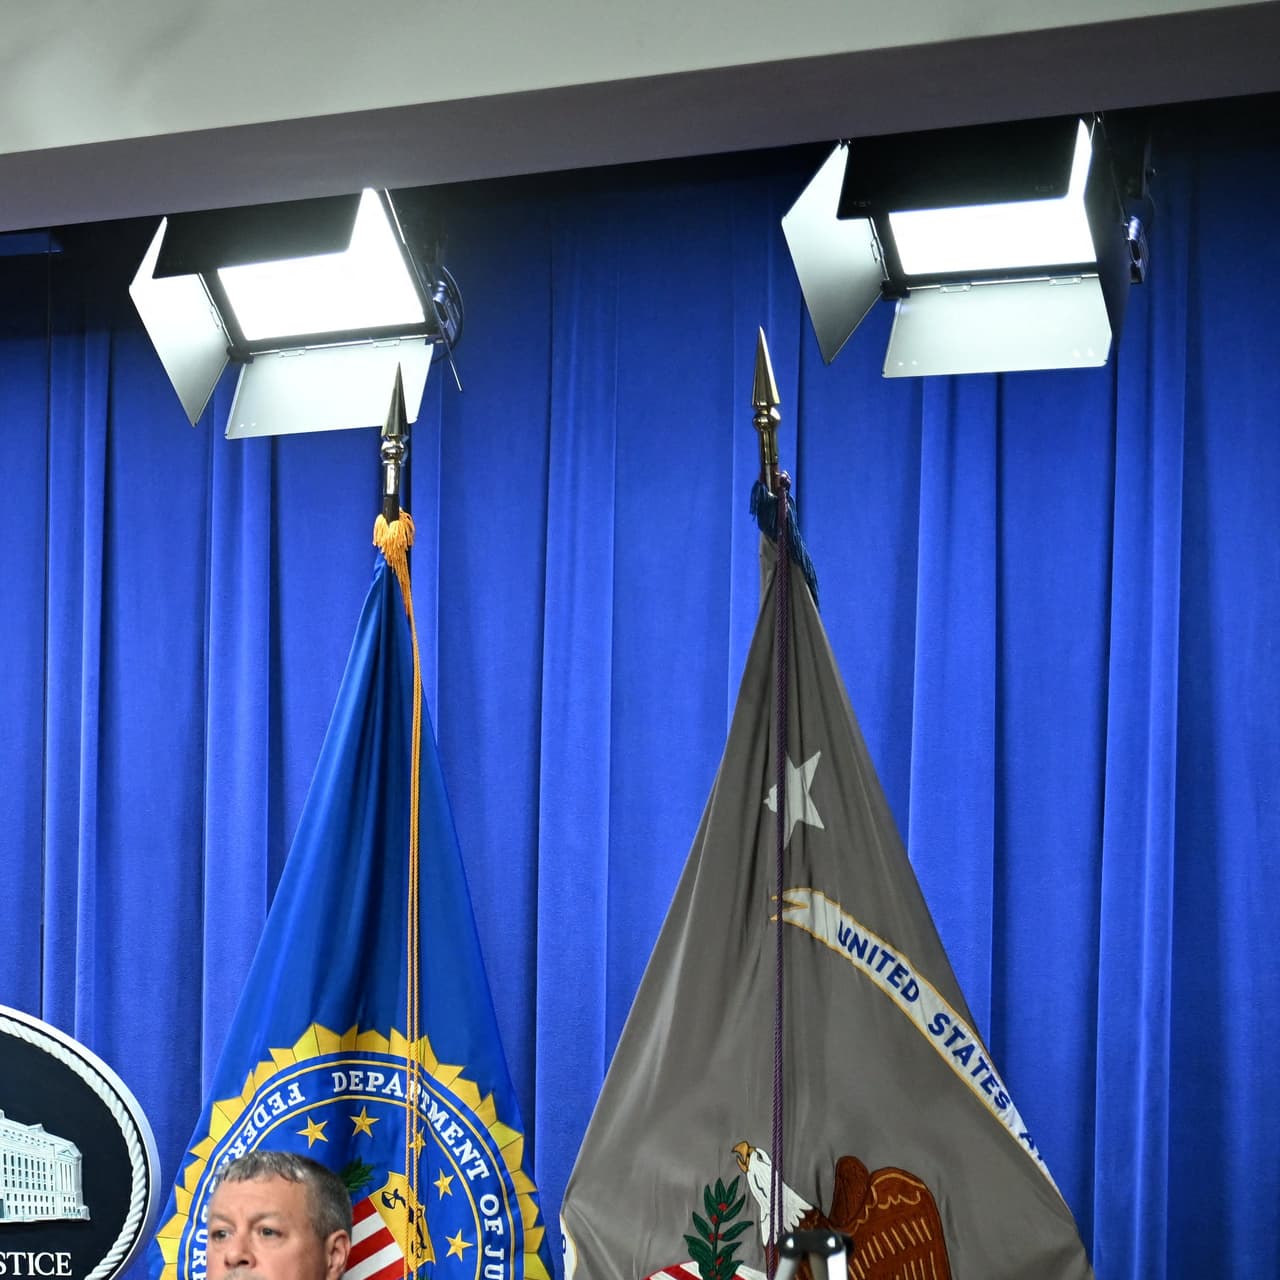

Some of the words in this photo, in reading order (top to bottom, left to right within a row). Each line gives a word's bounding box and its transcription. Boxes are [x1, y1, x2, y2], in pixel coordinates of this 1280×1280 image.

[838, 921, 919, 1003] UNITED
[928, 1013, 1011, 1110] STATES
[210, 1082, 306, 1193] FEDER
[480, 1194, 504, 1235] OF
